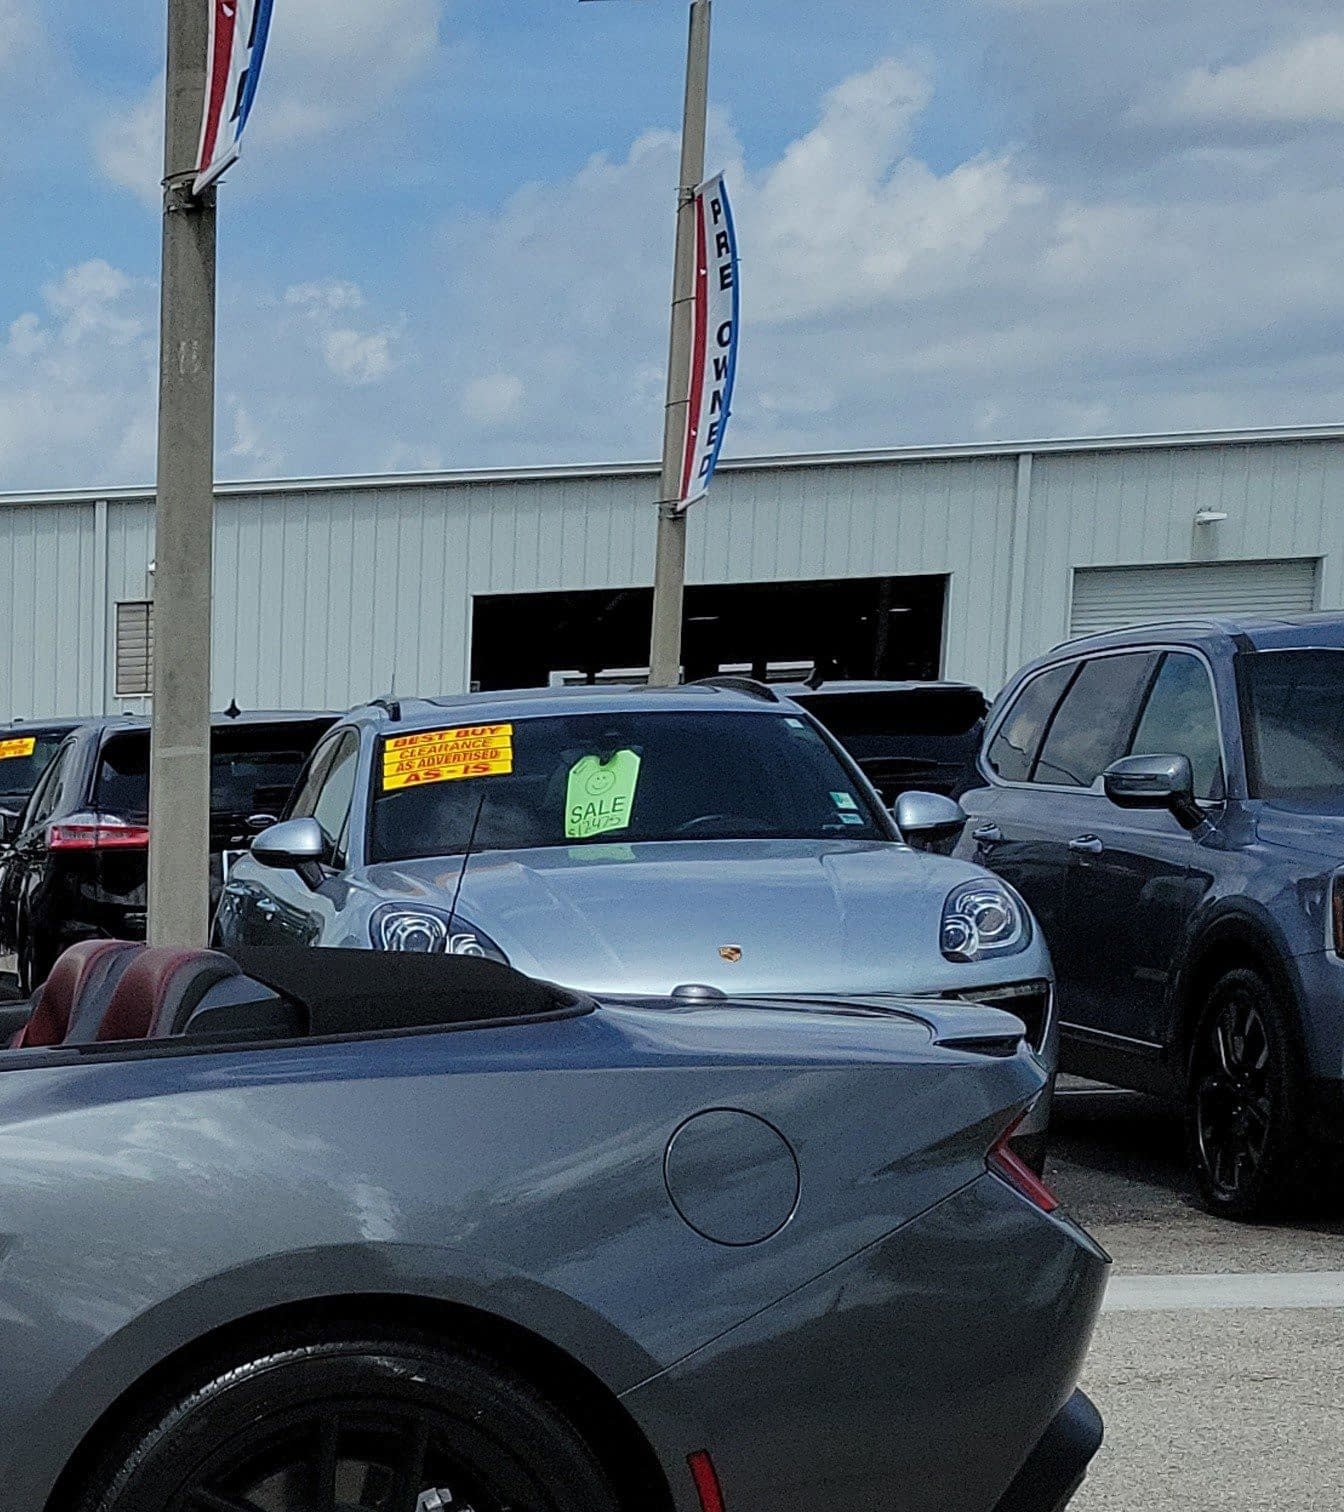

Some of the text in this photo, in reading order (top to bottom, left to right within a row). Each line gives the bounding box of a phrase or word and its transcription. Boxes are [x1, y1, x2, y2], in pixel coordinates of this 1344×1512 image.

[710, 199, 733, 290] PRE
[393, 727, 502, 748] BEST BUY
[399, 739, 492, 760] CLEARANCE
[396, 749, 500, 773] AS ADVERTISED
[570, 796, 626, 824] SALE
